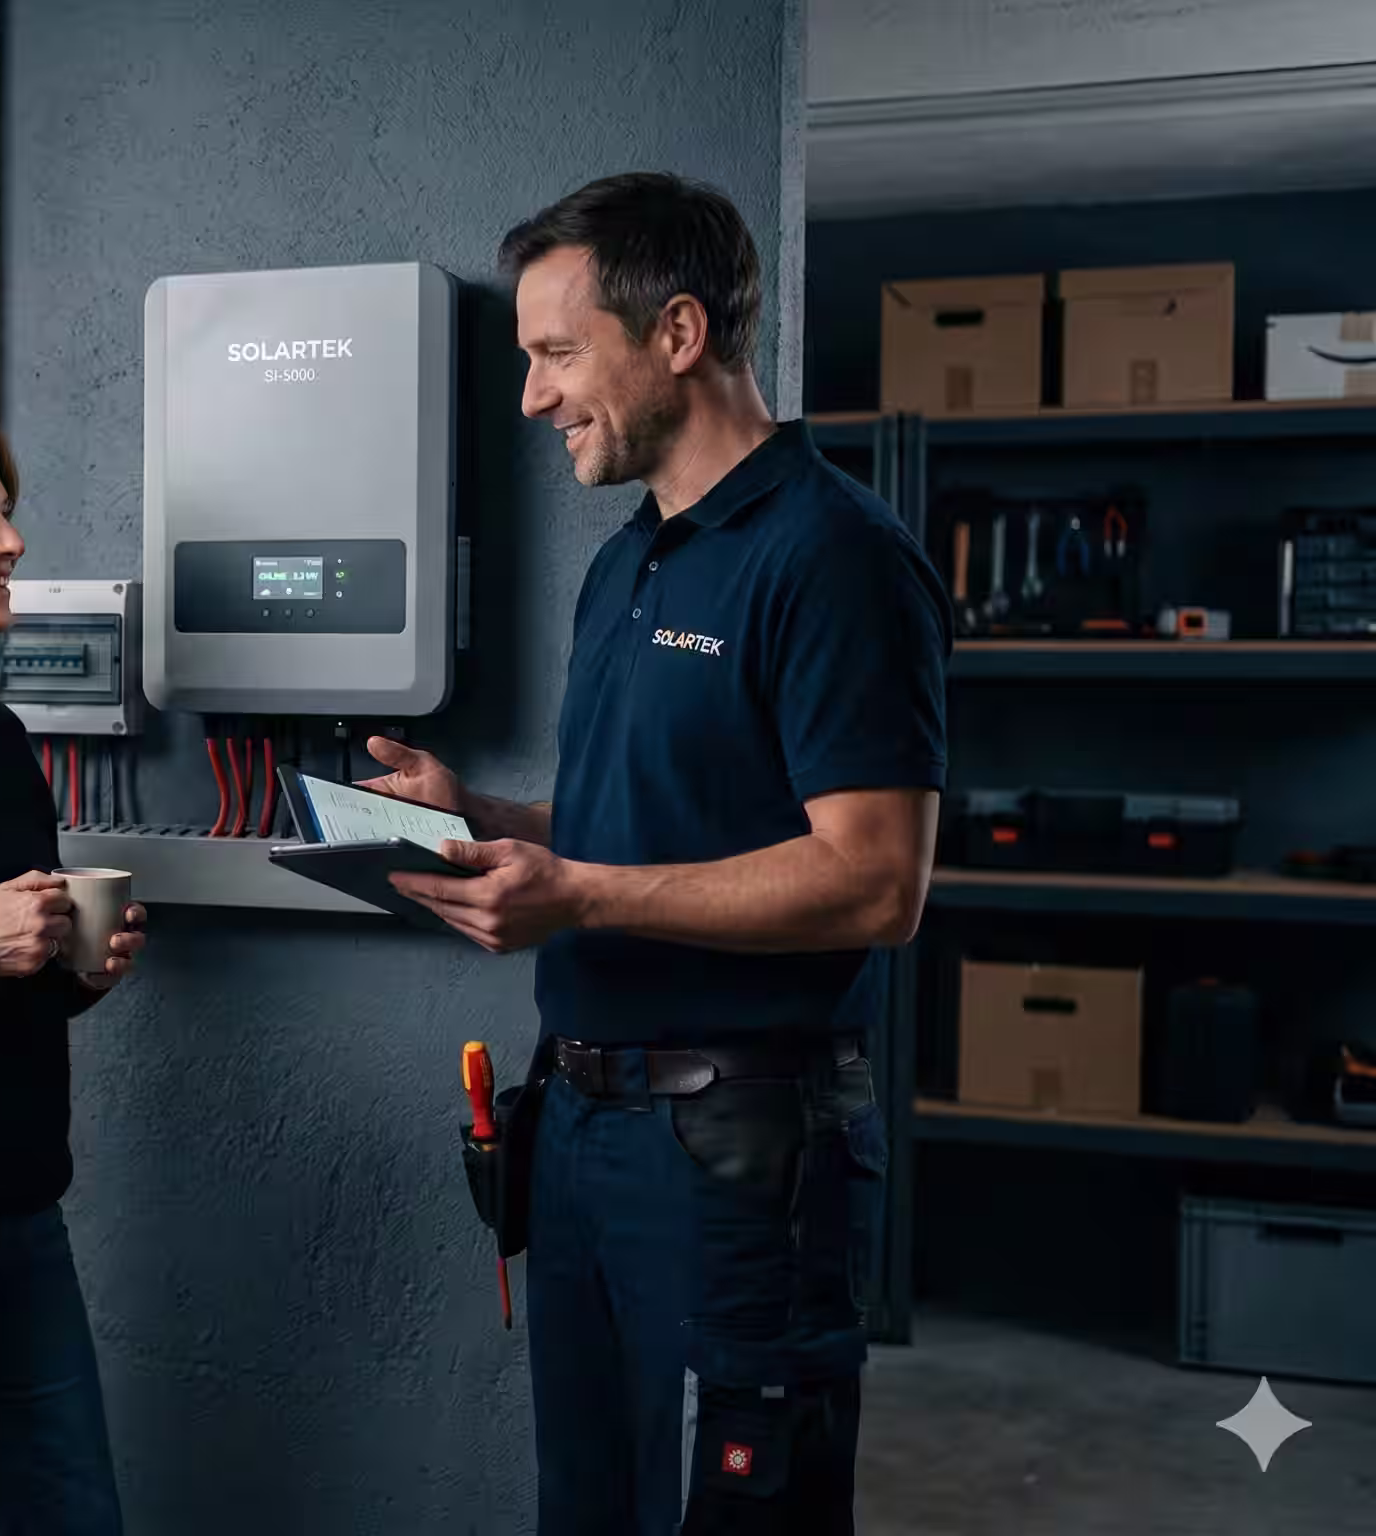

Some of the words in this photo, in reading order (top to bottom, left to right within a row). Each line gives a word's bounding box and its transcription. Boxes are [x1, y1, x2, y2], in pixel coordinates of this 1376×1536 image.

[227, 337, 353, 362] SOLARTEK
[264, 368, 316, 382] SI-5000
[652, 629, 724, 656] SOLARTEK
